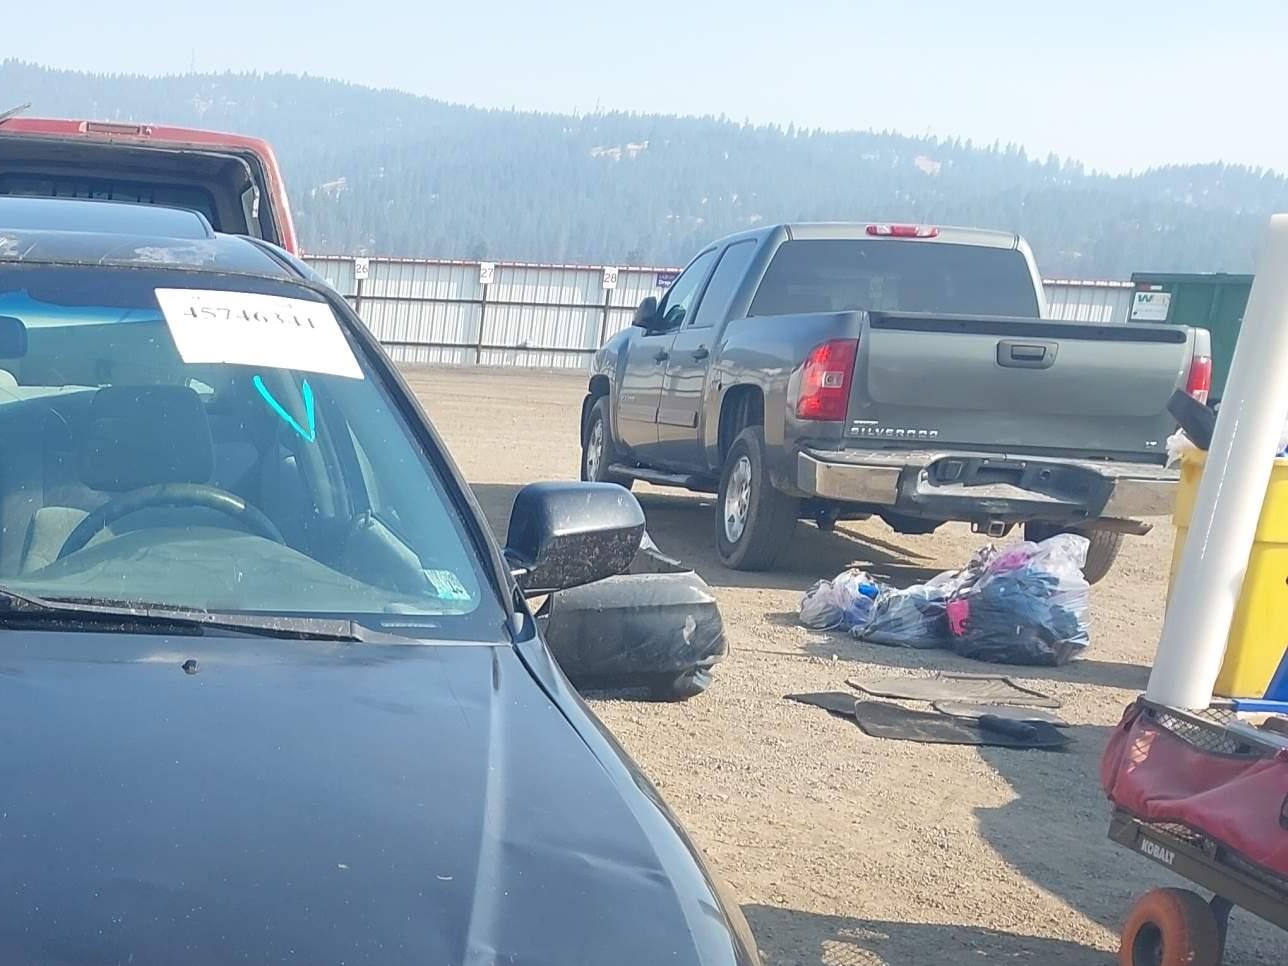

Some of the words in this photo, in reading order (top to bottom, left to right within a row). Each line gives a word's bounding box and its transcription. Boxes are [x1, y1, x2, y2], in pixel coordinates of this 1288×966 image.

[356, 263, 369, 274] 26
[480, 267, 494, 279] 27
[603, 272, 617, 283] 28
[850, 426, 939, 439] SILVERADO
[1140, 838, 1176, 865] KOBALT
